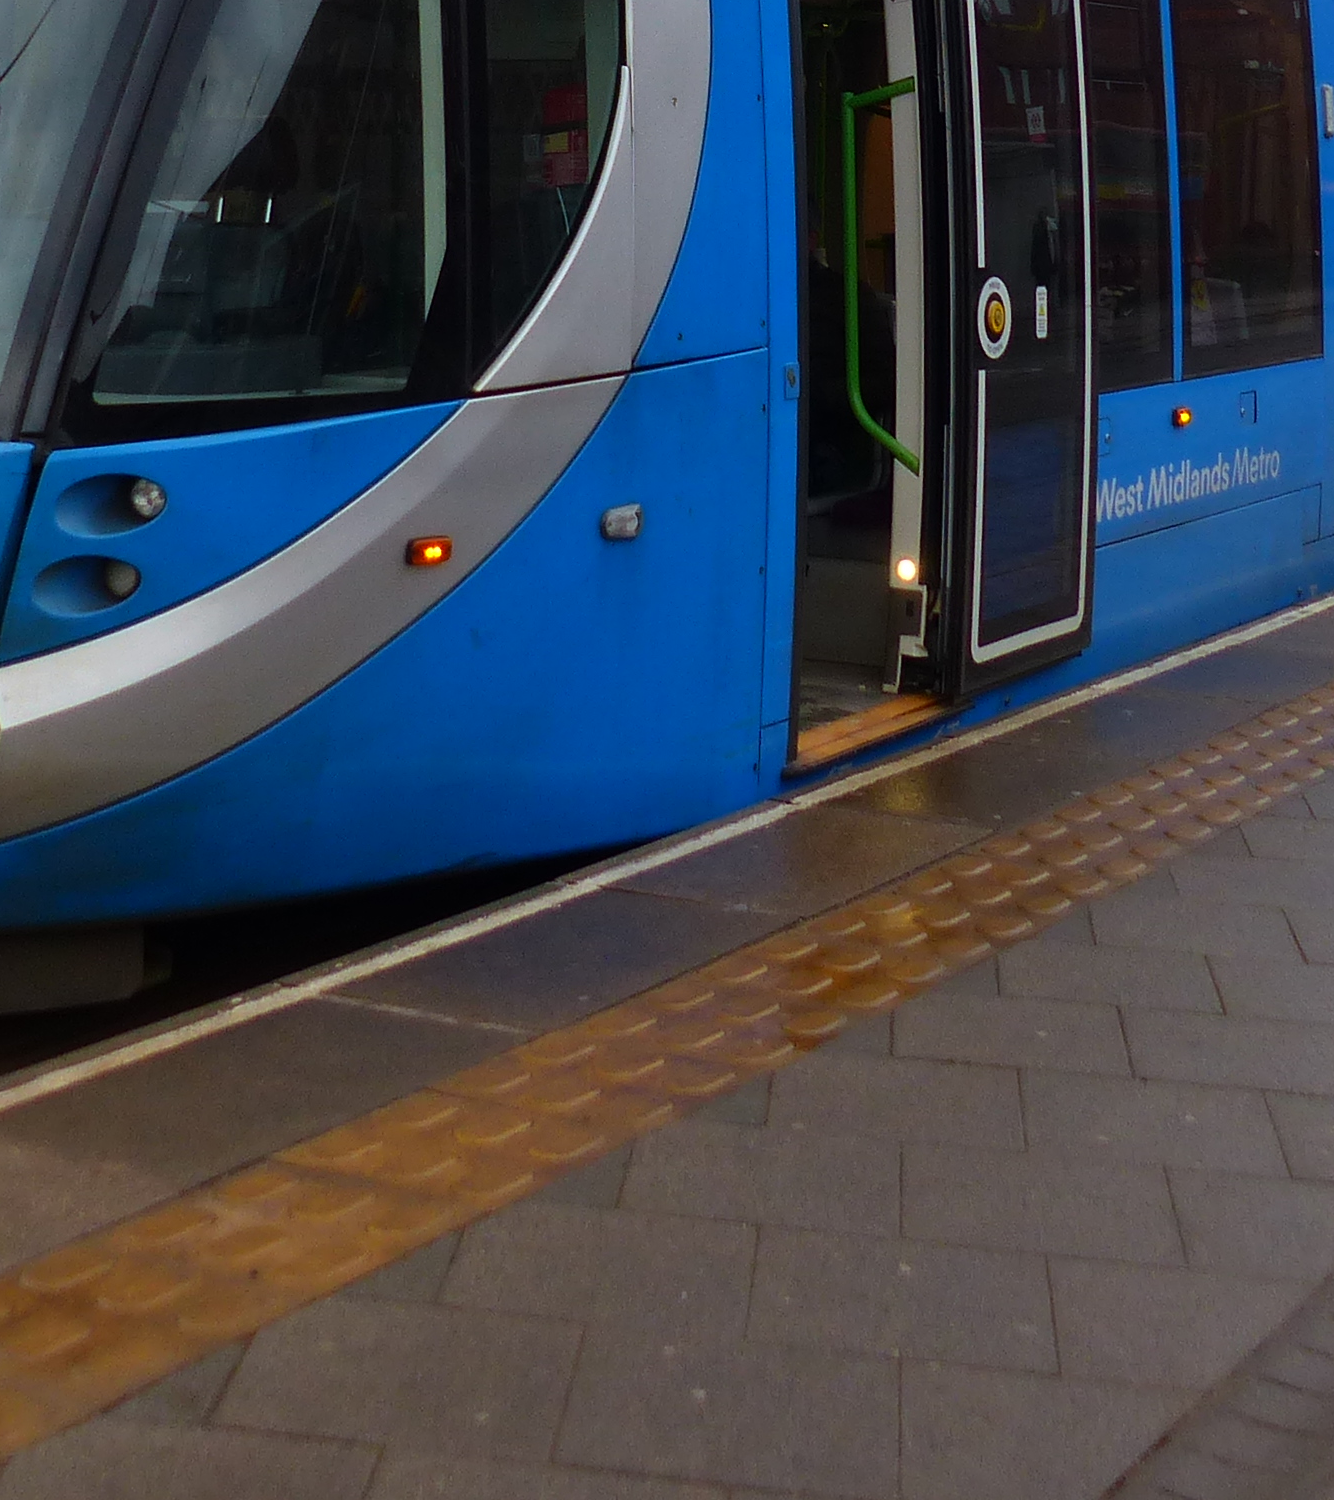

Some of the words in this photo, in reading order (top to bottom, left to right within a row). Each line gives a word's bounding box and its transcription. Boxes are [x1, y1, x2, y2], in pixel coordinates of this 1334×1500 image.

[1096, 475, 1145, 522] West
[1147, 452, 1230, 509] Midlands
[1231, 447, 1280, 488] Metro
